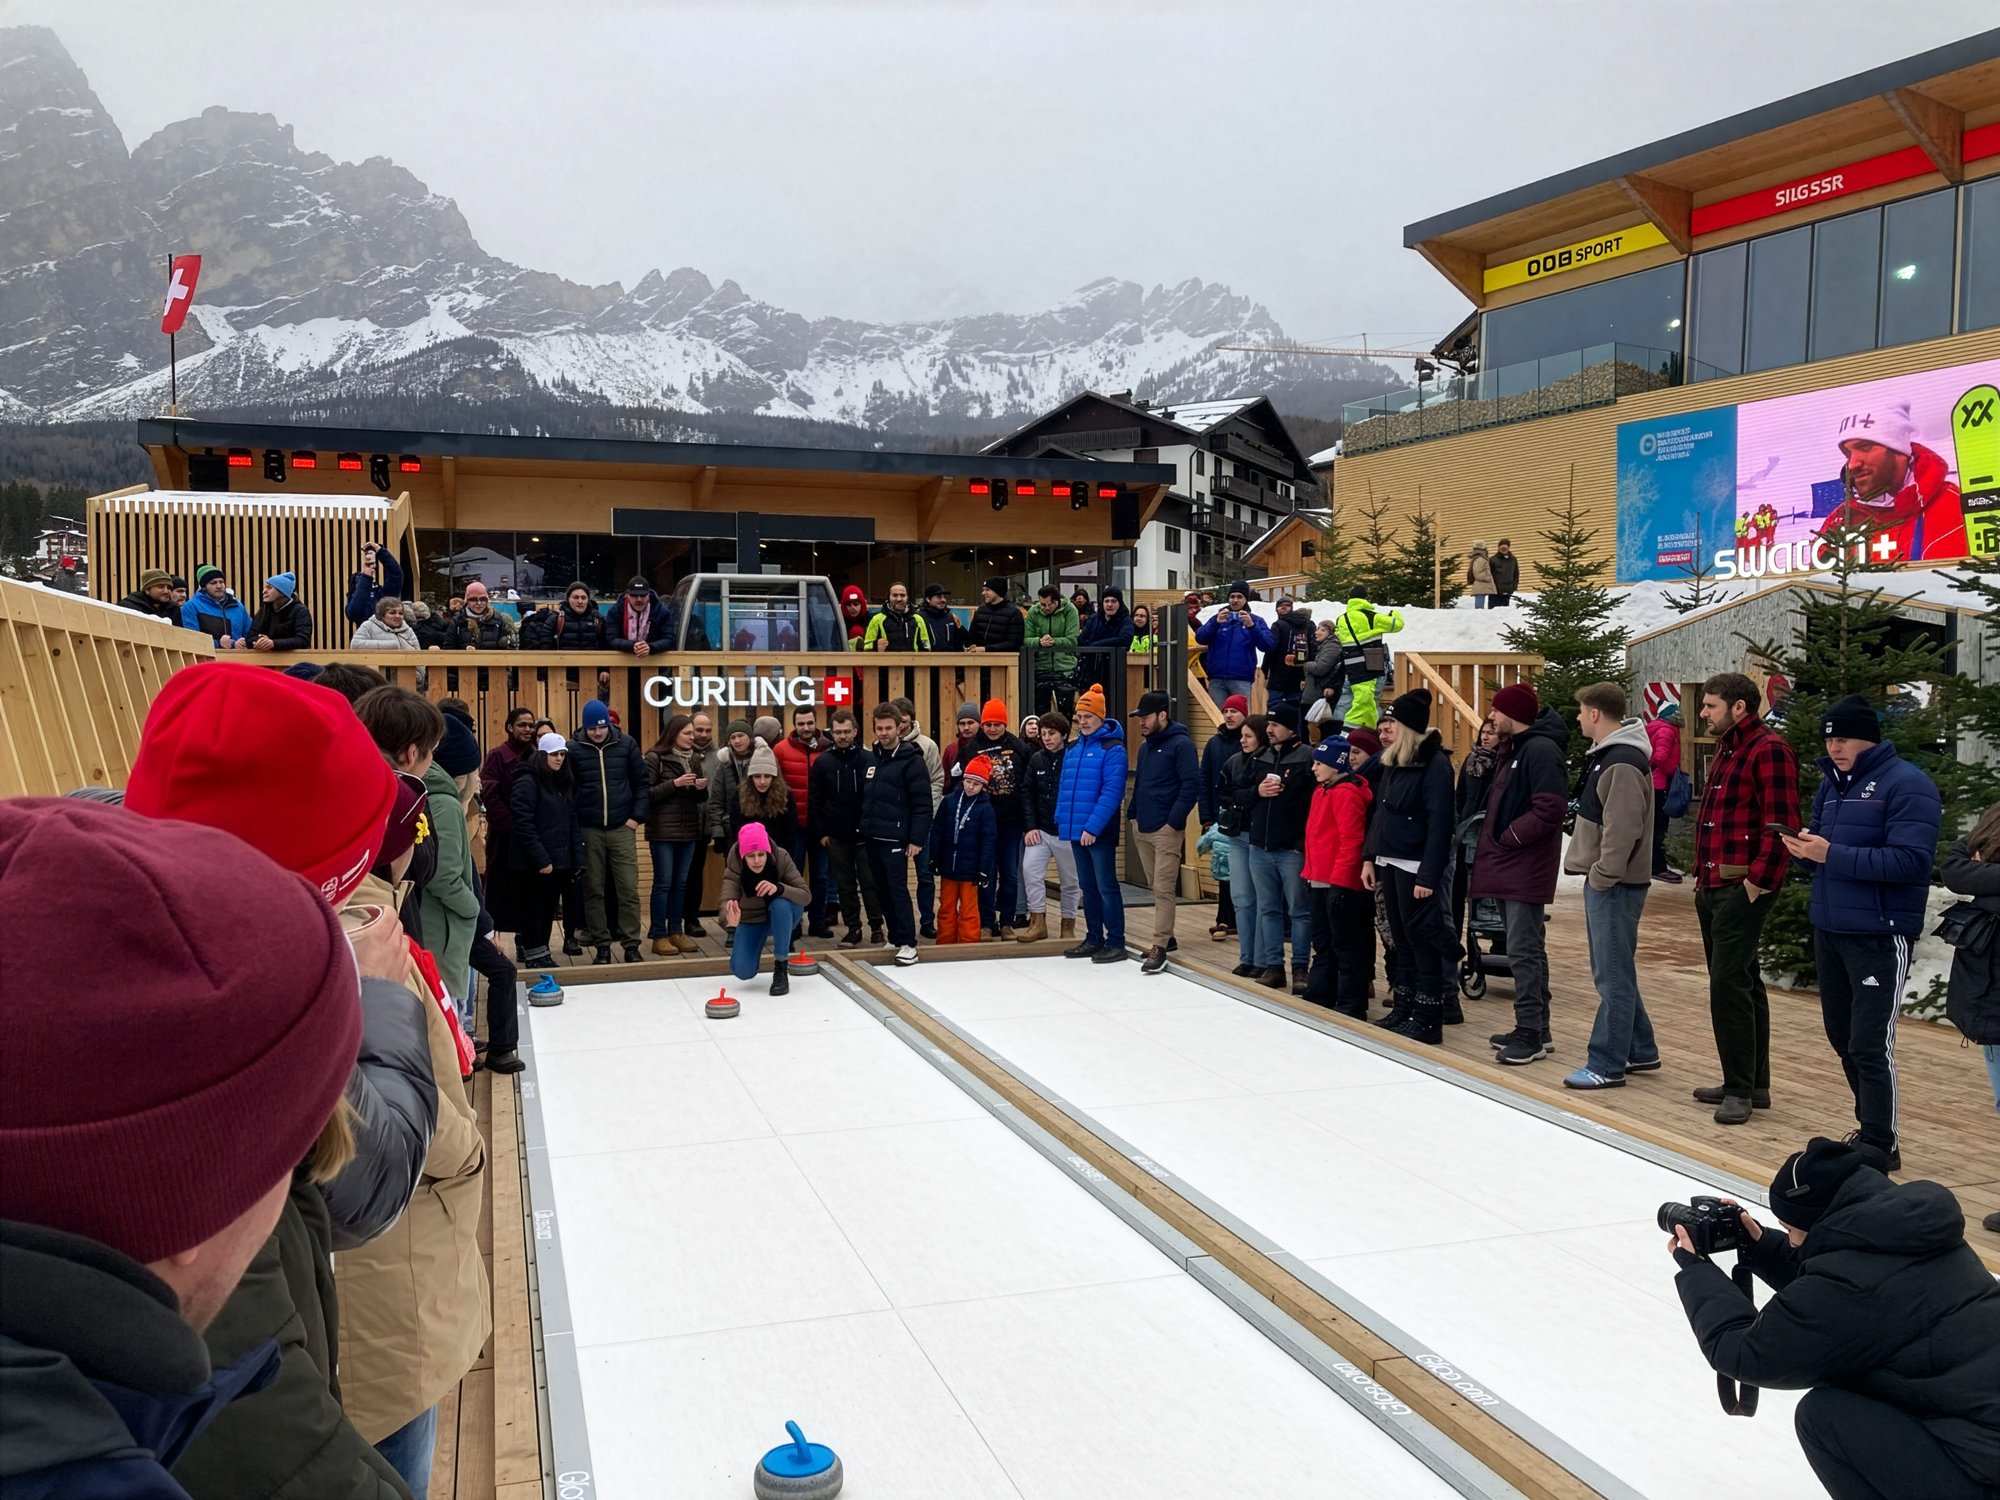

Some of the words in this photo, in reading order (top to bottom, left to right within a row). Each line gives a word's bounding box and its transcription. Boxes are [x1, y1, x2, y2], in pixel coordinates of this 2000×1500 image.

[1576, 237, 1623, 262] SPORT
[643, 675, 816, 707] CURLING
[557, 1470, 590, 1500] Glo
